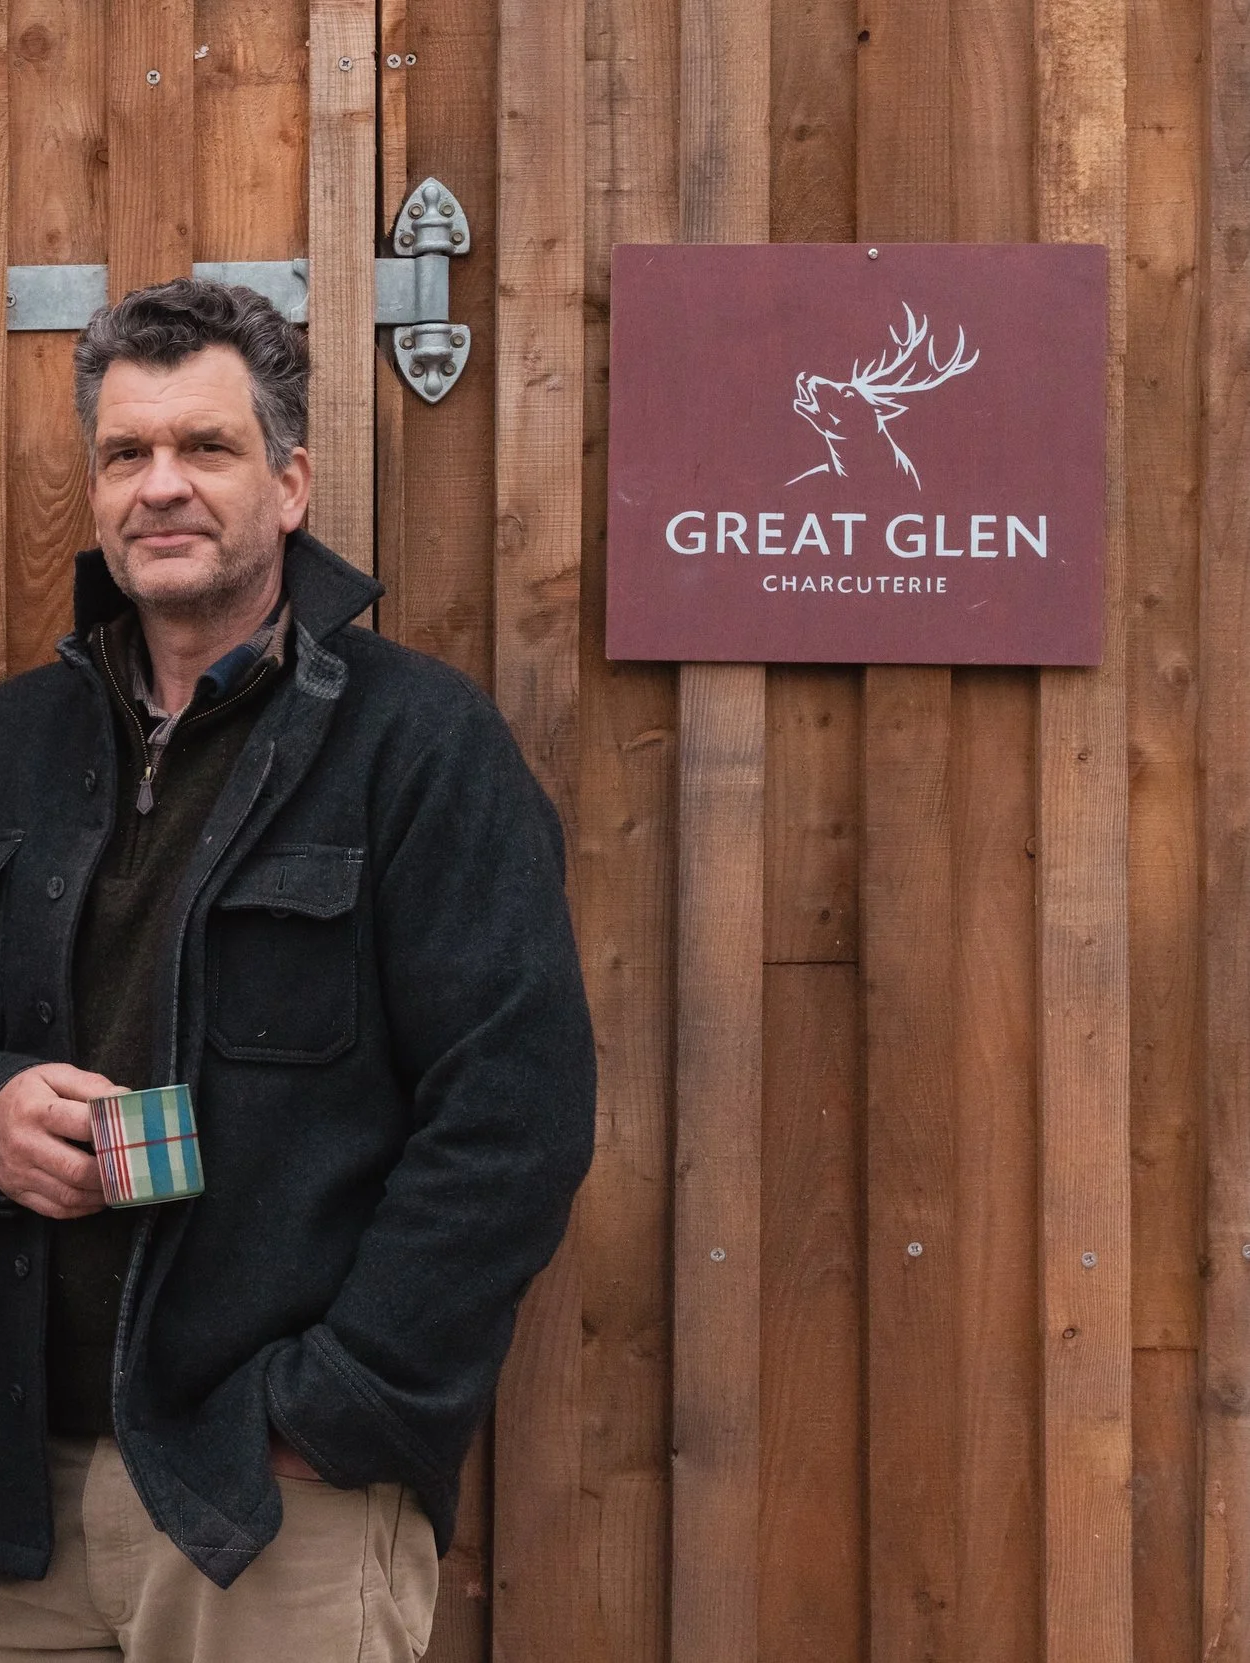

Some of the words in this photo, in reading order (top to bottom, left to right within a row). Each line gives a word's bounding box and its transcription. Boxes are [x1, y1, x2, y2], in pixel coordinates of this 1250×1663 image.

[665, 510, 866, 556] GREAT
[886, 514, 1047, 558] GLEN
[762, 574, 947, 593] CHARCUTERIE
